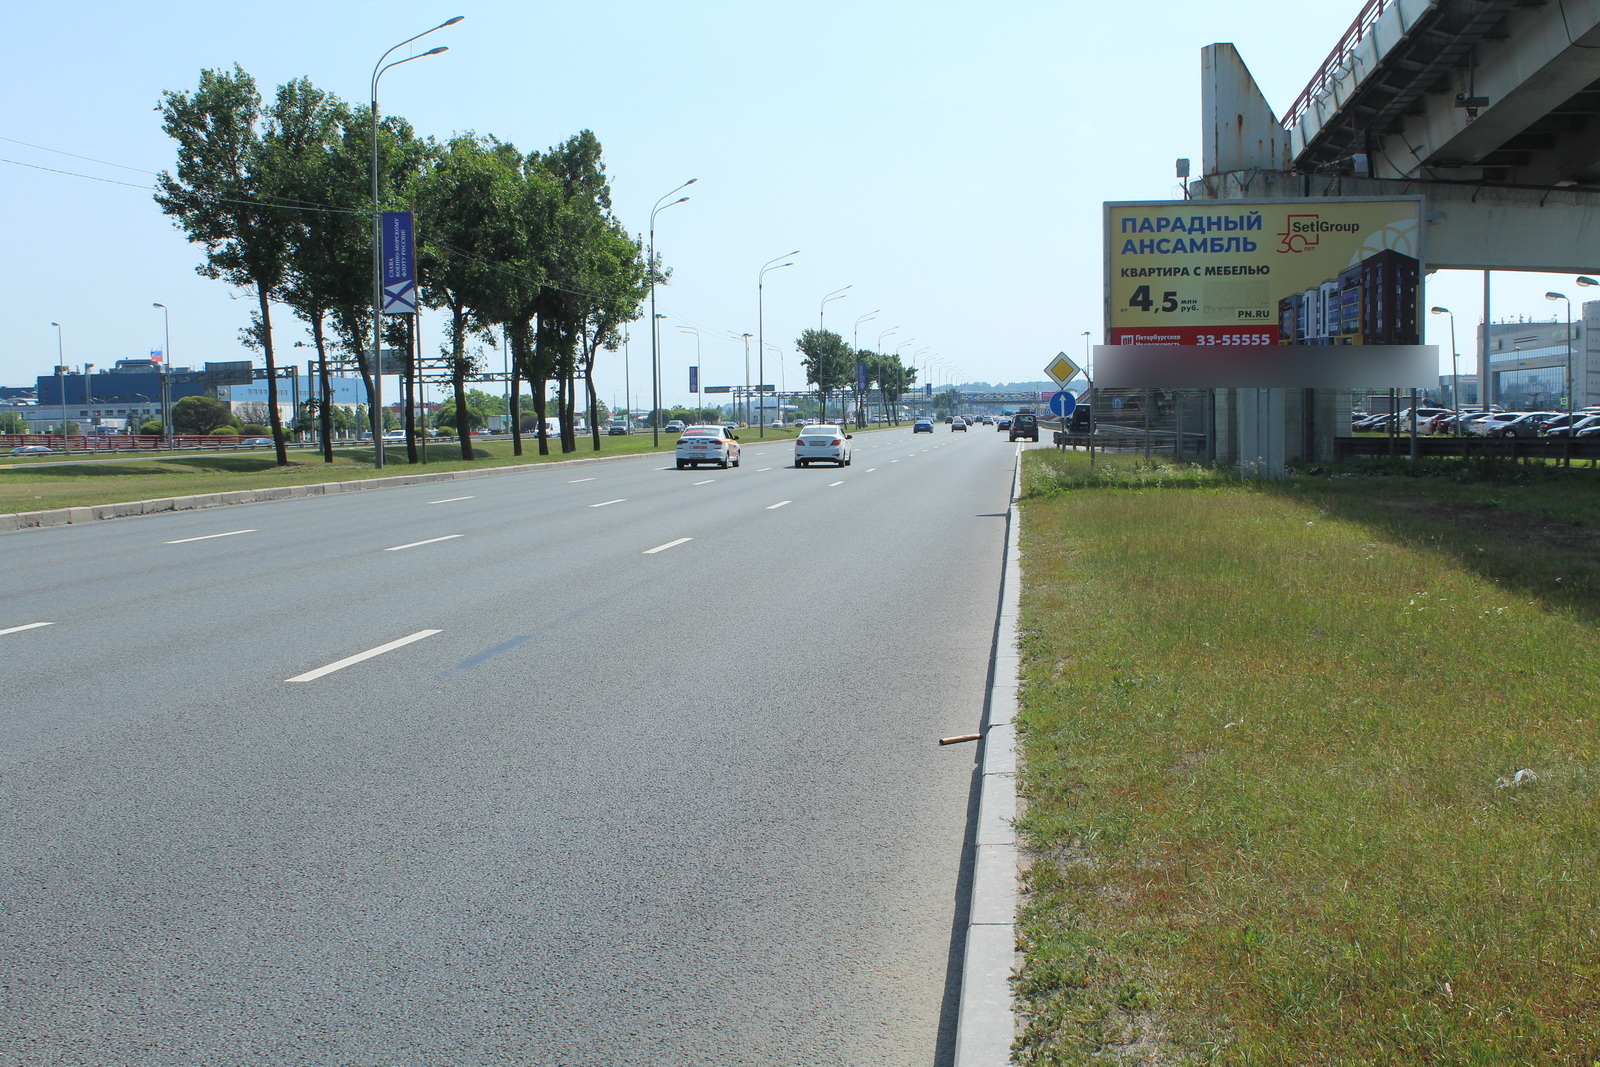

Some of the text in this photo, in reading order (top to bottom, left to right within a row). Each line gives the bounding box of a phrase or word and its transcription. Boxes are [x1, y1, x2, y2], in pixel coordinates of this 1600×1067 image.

[1121, 210, 1262, 235] ПАРАДНЫЙ
[1121, 236, 1257, 255] АНСАМБЛЬ
[1120, 264, 1270, 278] КВАРТИРА С МЕБЕЛЬЮ
[1129, 285, 1179, 314] 4,5
[1181, 305, 1199, 313] руб.
[1238, 310, 1270, 318] PN.RU
[1135, 334, 1181, 342] Петербургская
[1196, 334, 1270, 345] 33-55555
